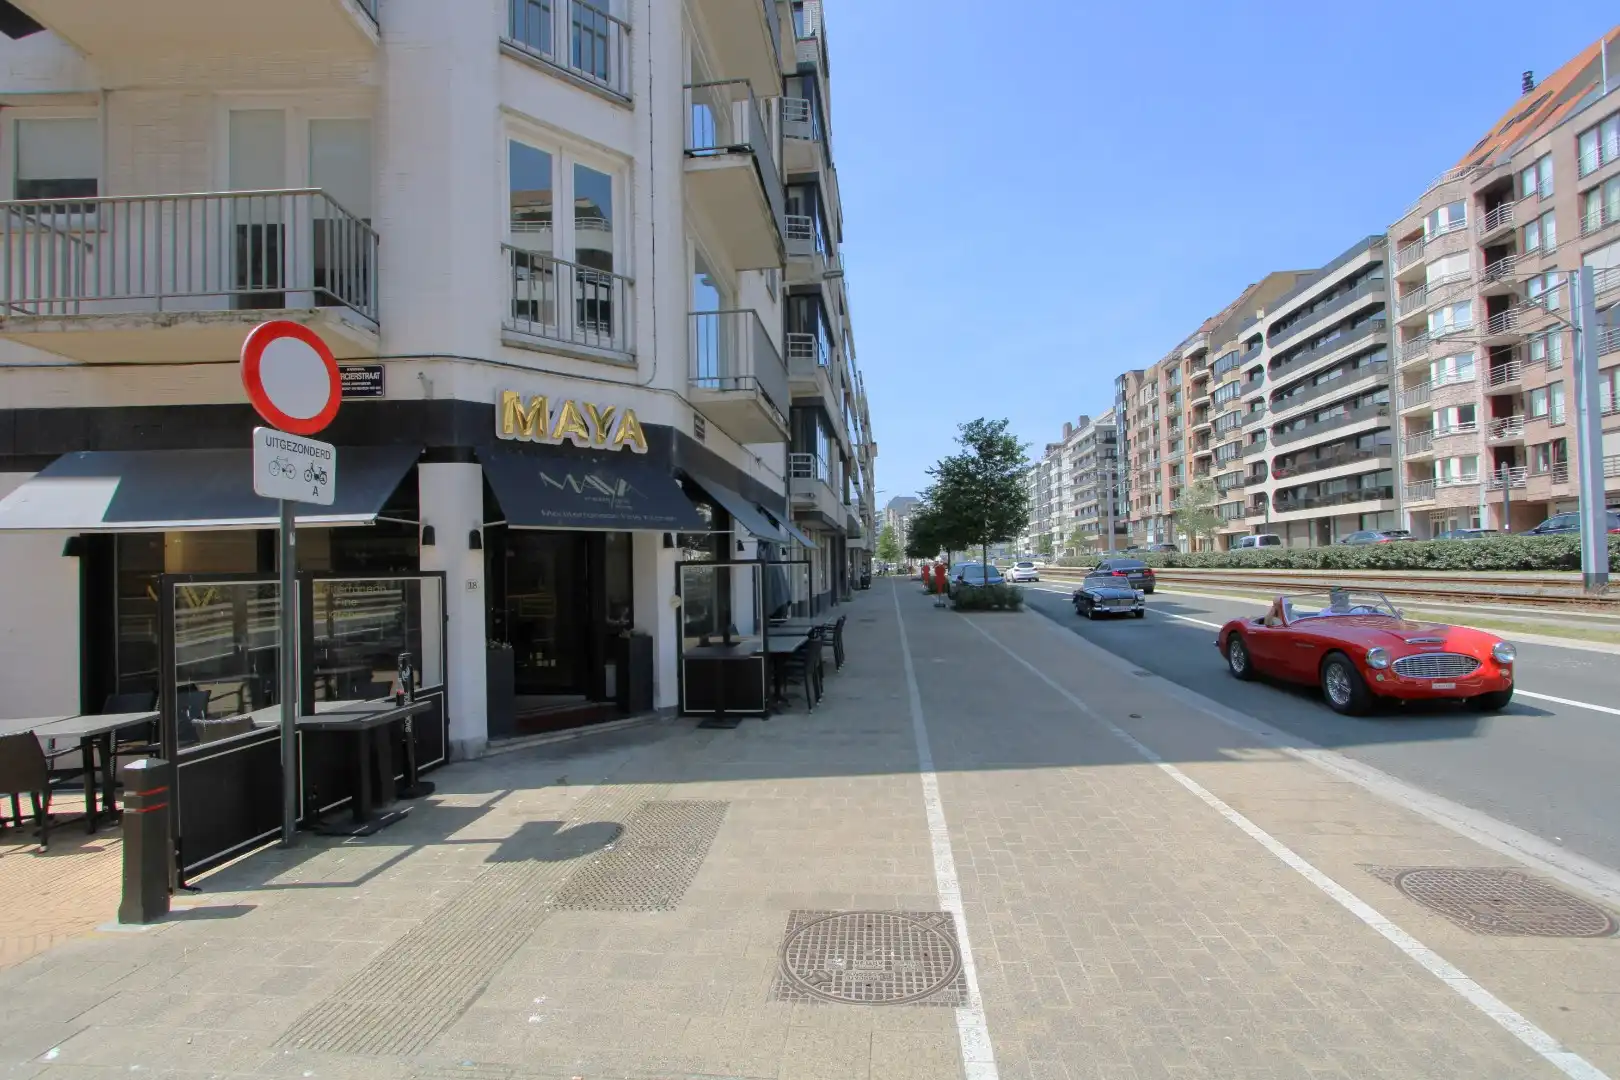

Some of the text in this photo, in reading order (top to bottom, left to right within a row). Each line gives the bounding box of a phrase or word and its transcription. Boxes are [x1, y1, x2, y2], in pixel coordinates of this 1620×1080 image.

[340, 371, 381, 381] RCIERSTRAAT
[499, 390, 649, 452] MAYA
[265, 435, 331, 460] UITGEZONDERD
[312, 485, 319, 497] A
[467, 581, 478, 590] 18
